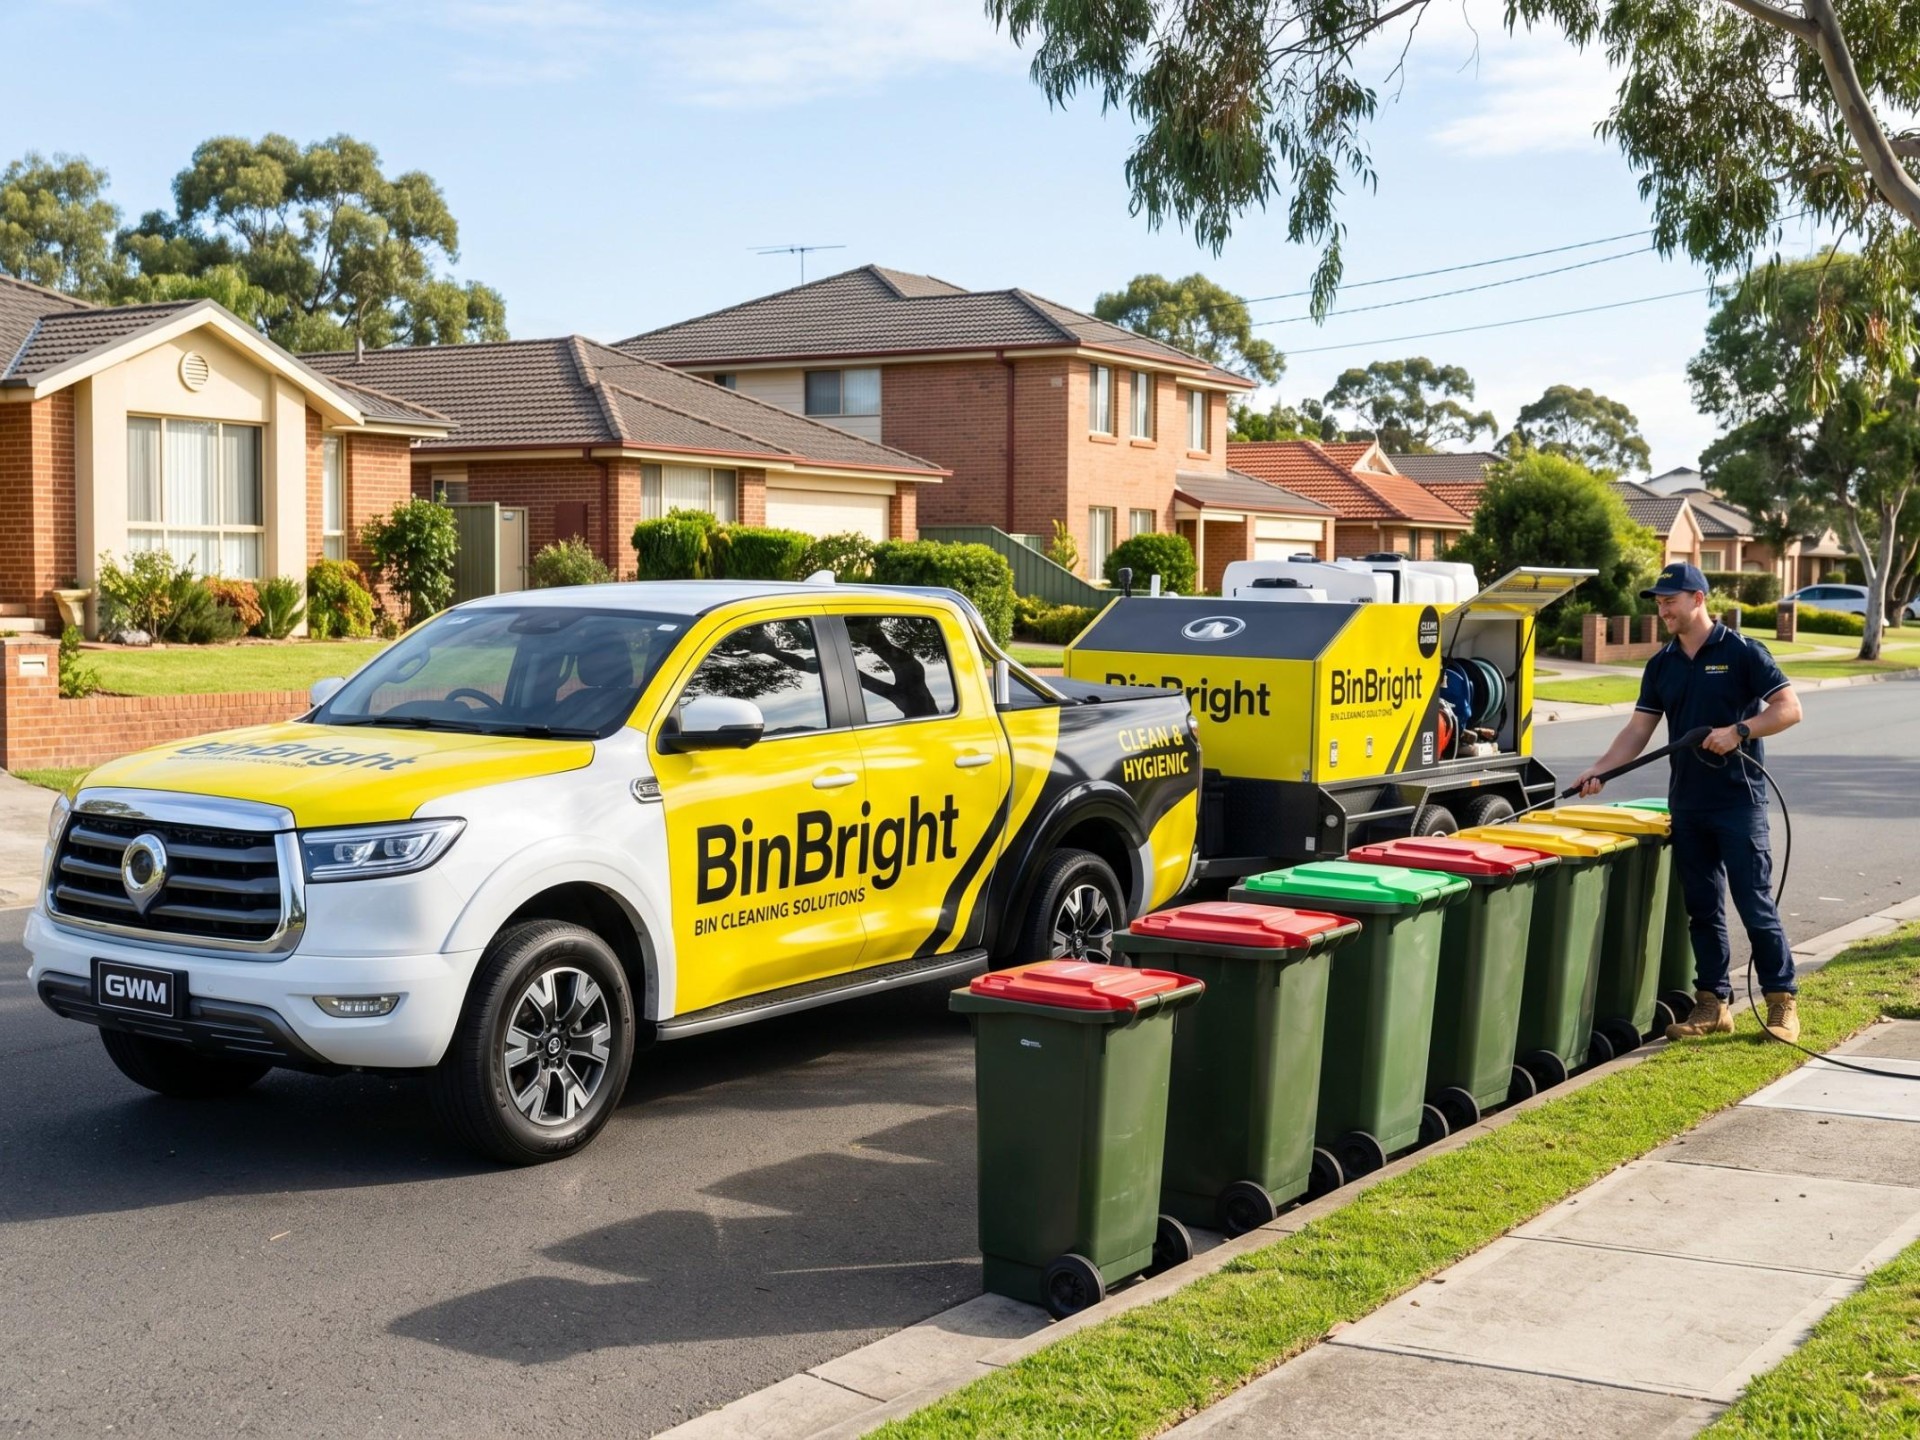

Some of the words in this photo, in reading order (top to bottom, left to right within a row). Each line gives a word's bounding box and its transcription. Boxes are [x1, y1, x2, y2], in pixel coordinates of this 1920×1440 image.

[1105, 673, 1271, 723] right
[1331, 667, 1422, 710] BinBright
[174, 741, 419, 771] BinBright
[1118, 725, 1170, 752] CLEAN
[1171, 724, 1184, 746] &
[1123, 751, 1190, 783] HYGIENIC
[697, 794, 959, 905] BinBright
[695, 916, 718, 936] BIN
[721, 902, 789, 930] CLEANING
[793, 887, 866, 915] SOLUTIONS
[105, 974, 167, 1005] GWM
